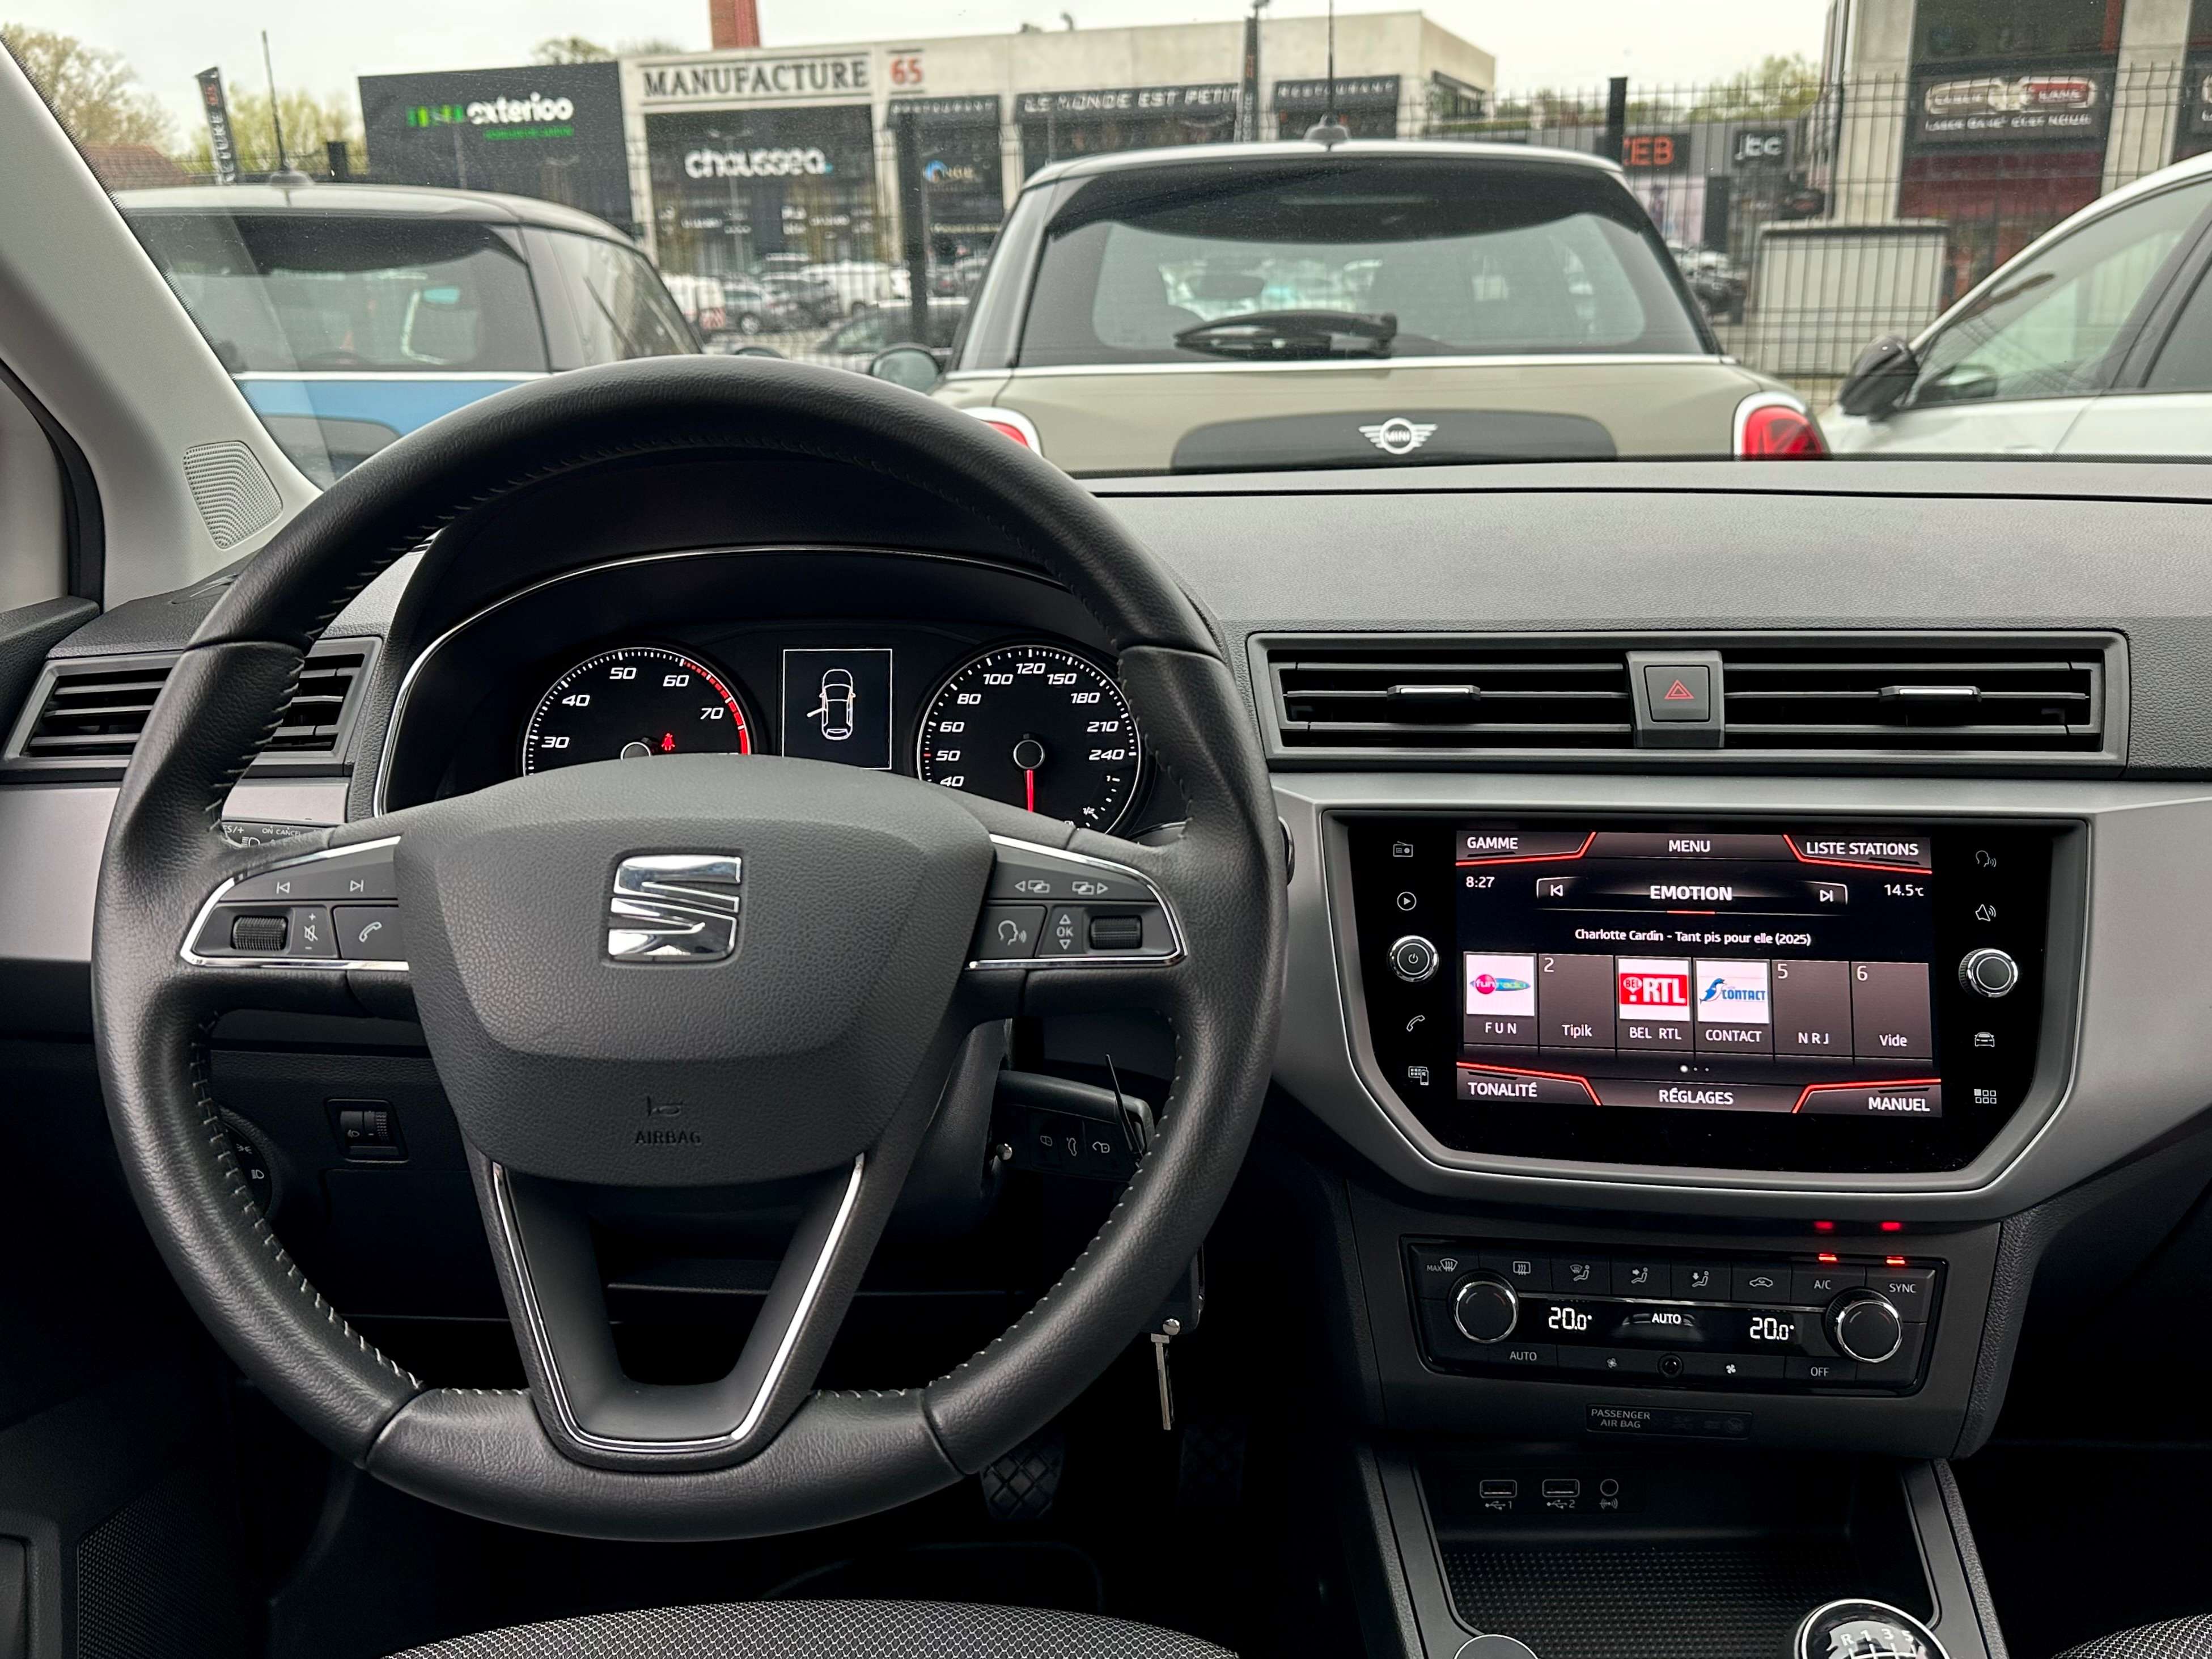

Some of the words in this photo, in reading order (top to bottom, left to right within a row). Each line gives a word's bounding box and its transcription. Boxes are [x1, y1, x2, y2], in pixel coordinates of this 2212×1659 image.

[643, 60, 868, 97] MANUFACTURE
[891, 57, 923, 84] 65
[1024, 96, 1053, 112] LE
[1057, 90, 1132, 111] MONDE
[1138, 90, 1179, 108] EST
[467, 92, 574, 125] exterioo
[1384, 430, 1410, 442] MINI
[609, 667, 637, 680] 50
[1016, 663, 1045, 674] 120
[663, 675, 689, 687] 60
[982, 674, 1014, 685] 100
[1046, 673, 1077, 685] 150
[562, 695, 591, 707] 40
[957, 693, 981, 705] 80
[1070, 692, 1100, 704] 180
[700, 707, 724, 720] 70
[939, 721, 965, 733] 60
[1087, 721, 1118, 733] 210
[541, 737, 570, 748] 30
[935, 750, 960, 761] 50
[1088, 749, 1125, 760] 240
[940, 776, 964, 788] 40
[1467, 836, 1519, 850] GAMME
[1668, 839, 1710, 852] MENU
[1807, 841, 1845, 855] LISTE
[1849, 843, 1919, 856] STATIONS
[1465, 876, 1495, 888] 8:27
[1650, 886, 1732, 901] EMOTION
[1056, 927, 1073, 937] OK
[1575, 929, 1626, 941] Charlotte
[1629, 929, 1663, 941] Cardin
[1675, 931, 1701, 942] Tant
[1704, 932, 1721, 945] pis
[1724, 934, 1752, 945] pour
[1754, 932, 1773, 943] elle
[1775, 932, 1811, 946] (2025)
[1544, 957, 1554, 972] 2
[1777, 963, 1789, 979] 5
[1857, 965, 1868, 981] 6
[1643, 977, 1686, 1004] RTL
[1562, 1024, 1592, 1038] Tipik
[1629, 1027, 1652, 1039] BEL
[1659, 1028, 1682, 1040] RTL
[1705, 1029, 1762, 1043] CONTACT
[1879, 1034, 1908, 1047] Vide
[1467, 1082, 1538, 1098] TONALITÉ
[1659, 1087, 1734, 1105] RÉGLAGES
[1868, 1097, 1930, 1112] MANUEL
[634, 1131, 702, 1144] AIRBAG
[1426, 1264, 1442, 1272] MAX
[1814, 1279, 1832, 1290] A/C
[1889, 1283, 1917, 1294] SYNC
[1651, 1313, 1682, 1325] AUTO
[1510, 1351, 1537, 1361] AUTO
[1811, 1367, 1830, 1377] OFF
[1591, 1408, 1651, 1420] PASSENGER
[1620, 1420, 1641, 1429] BAG
[1569, 1500, 1575, 1509] 2
[1841, 1633, 1855, 1646] R
[1861, 1630, 1872, 1642] 1
[1882, 1628, 1895, 1640] 3
[1902, 1631, 1914, 1642] 5
